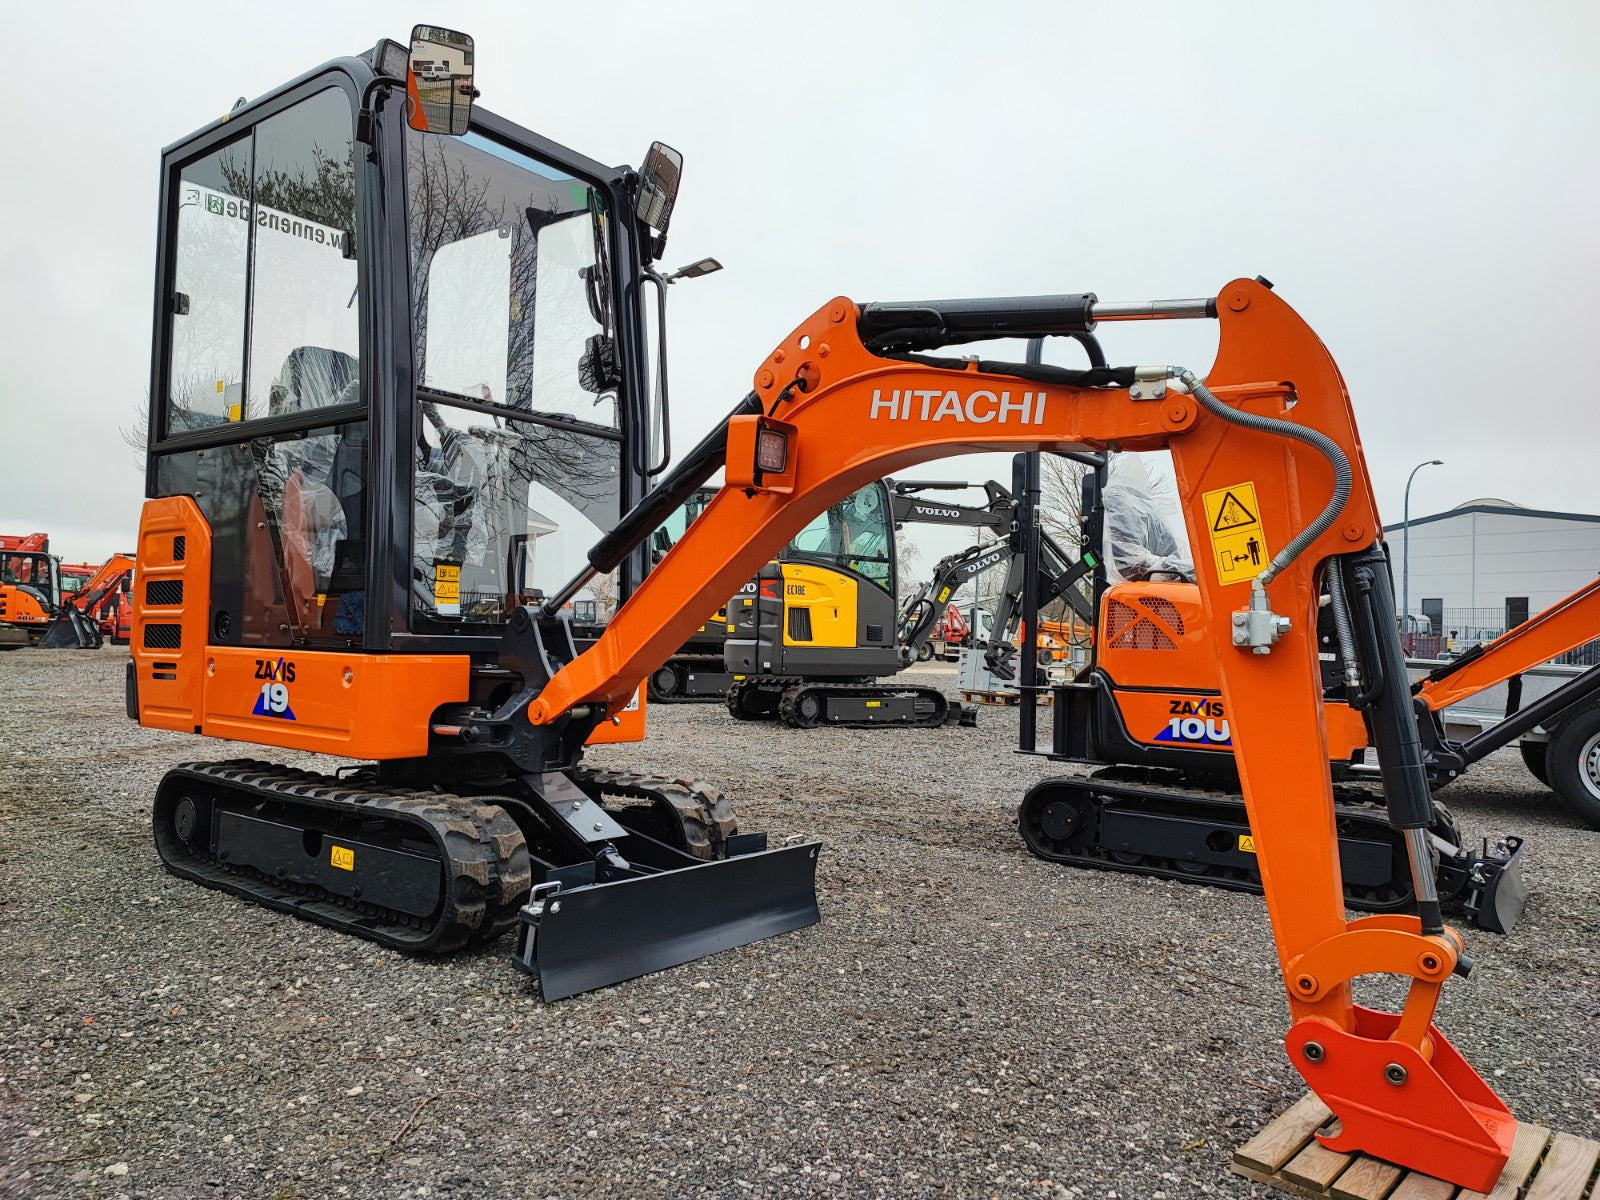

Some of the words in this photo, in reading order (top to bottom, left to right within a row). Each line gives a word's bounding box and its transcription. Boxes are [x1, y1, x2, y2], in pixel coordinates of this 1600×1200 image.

[870, 389, 1047, 425] HITACHI
[915, 506, 960, 518] VOLVO
[962, 553, 1000, 573] OLVO
[787, 584, 806, 596] EC18E
[255, 657, 296, 683] ZAXIS
[261, 682, 289, 714] 19
[1169, 698, 1224, 717] ZAXIS
[1168, 717, 1231, 742] 10U
